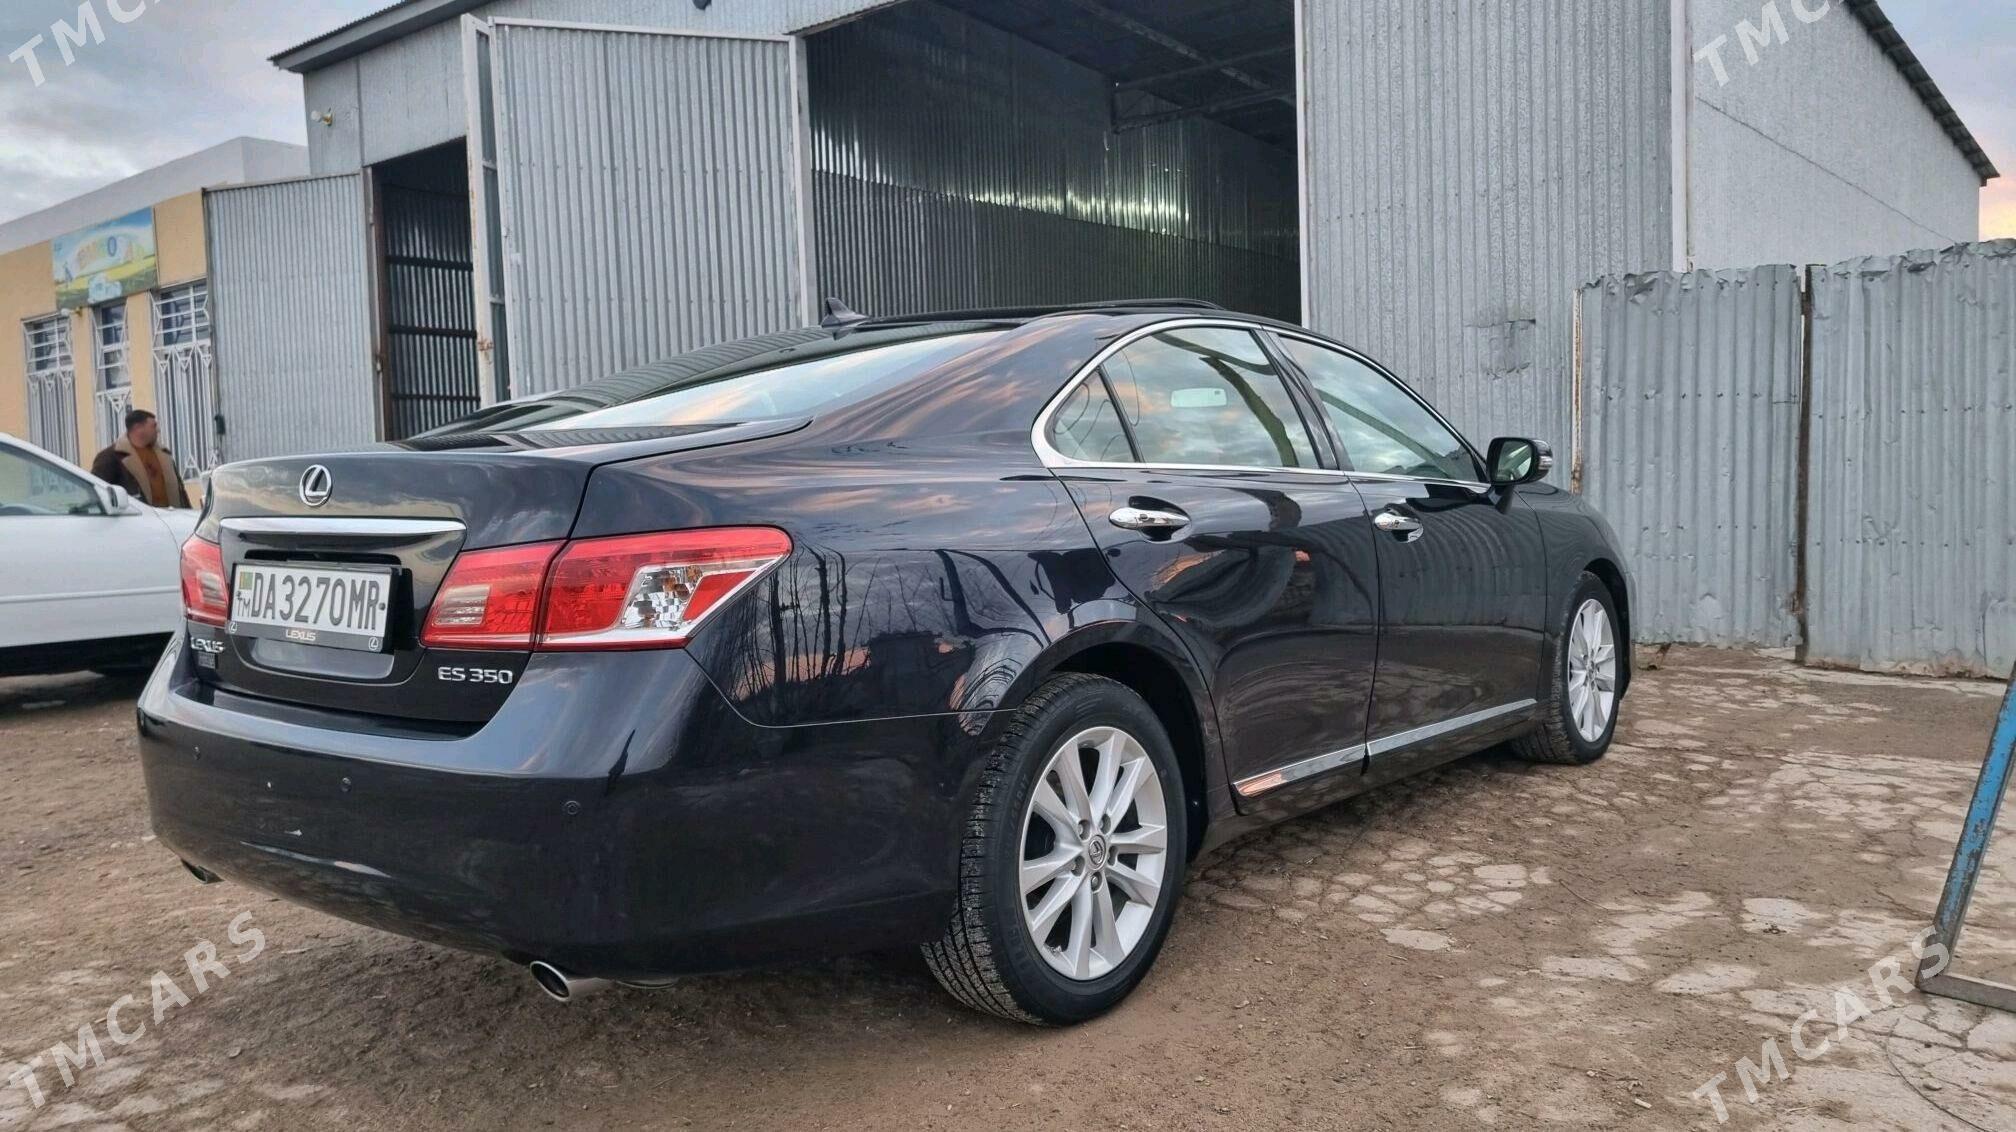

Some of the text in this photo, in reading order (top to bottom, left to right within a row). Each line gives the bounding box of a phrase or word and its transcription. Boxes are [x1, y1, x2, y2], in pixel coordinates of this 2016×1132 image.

[251, 572, 380, 631] DA3270MR
[285, 629, 317, 642] LEXUS
[190, 636, 225, 654] LEXUS
[438, 666, 514, 684] ES 350
